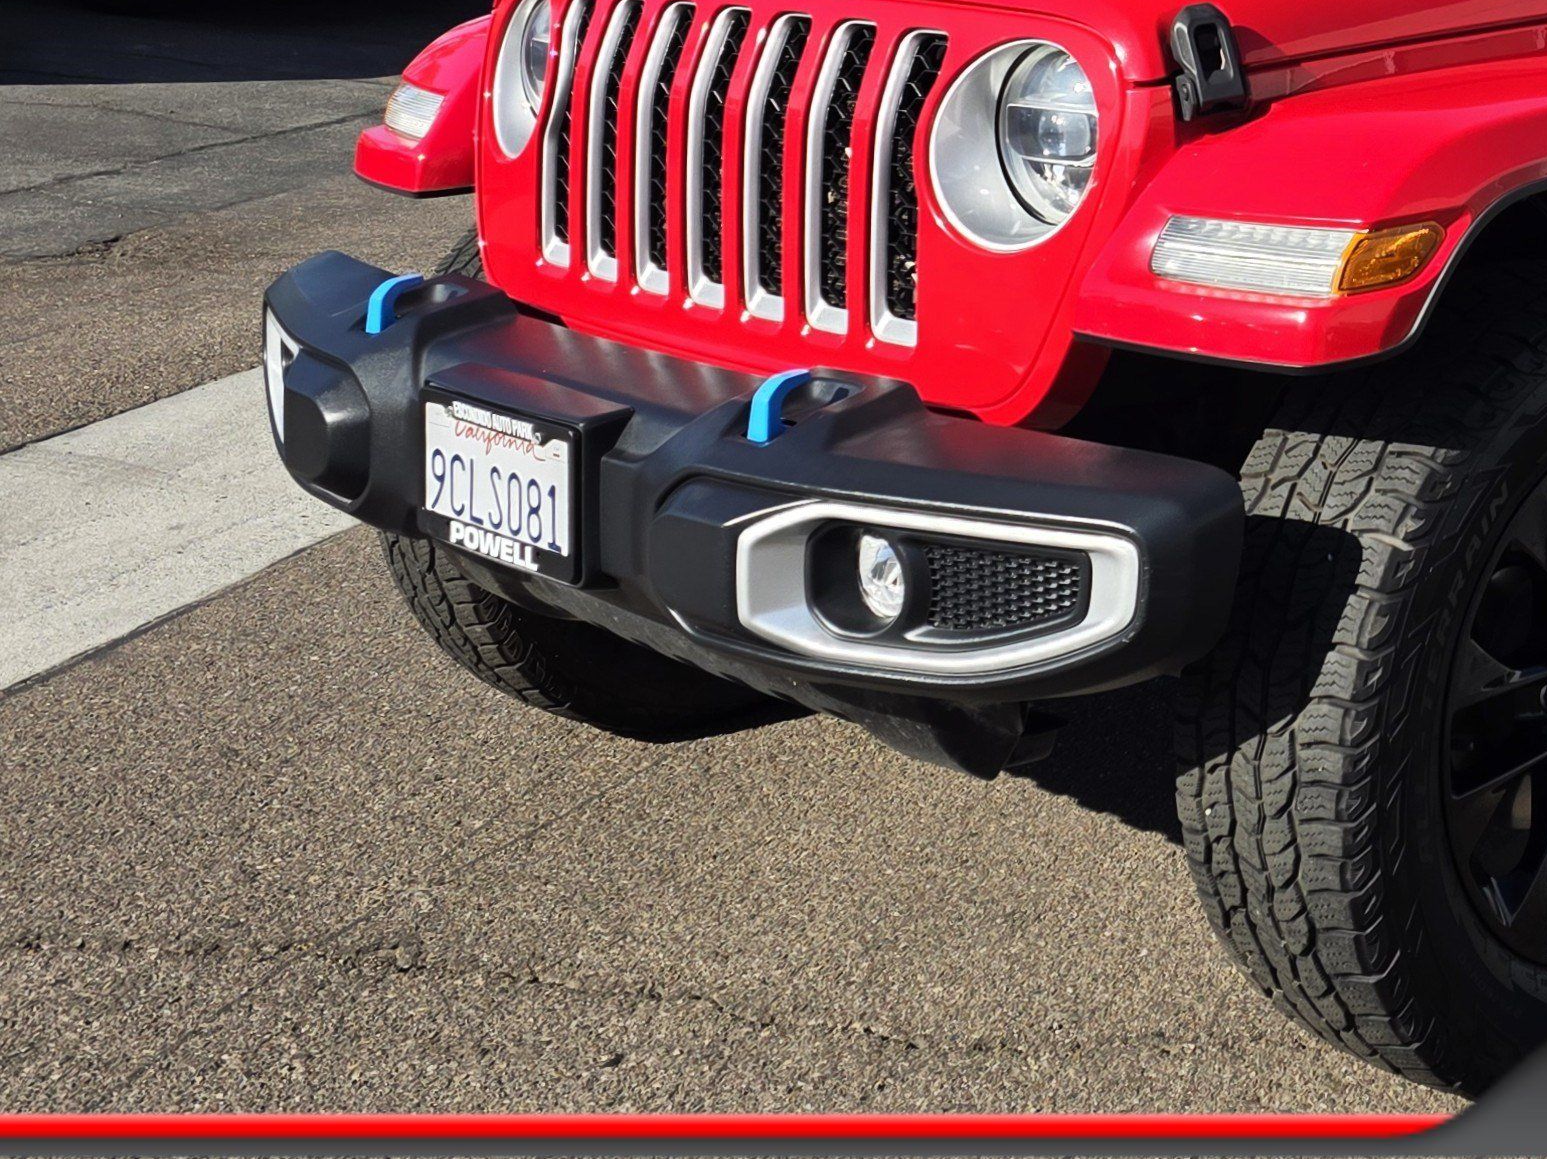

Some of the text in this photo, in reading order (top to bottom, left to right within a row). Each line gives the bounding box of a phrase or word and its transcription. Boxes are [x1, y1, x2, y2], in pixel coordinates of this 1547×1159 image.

[454, 420, 546, 461] California
[431, 448, 562, 553] 9CLS081
[450, 521, 539, 571] POWELL
